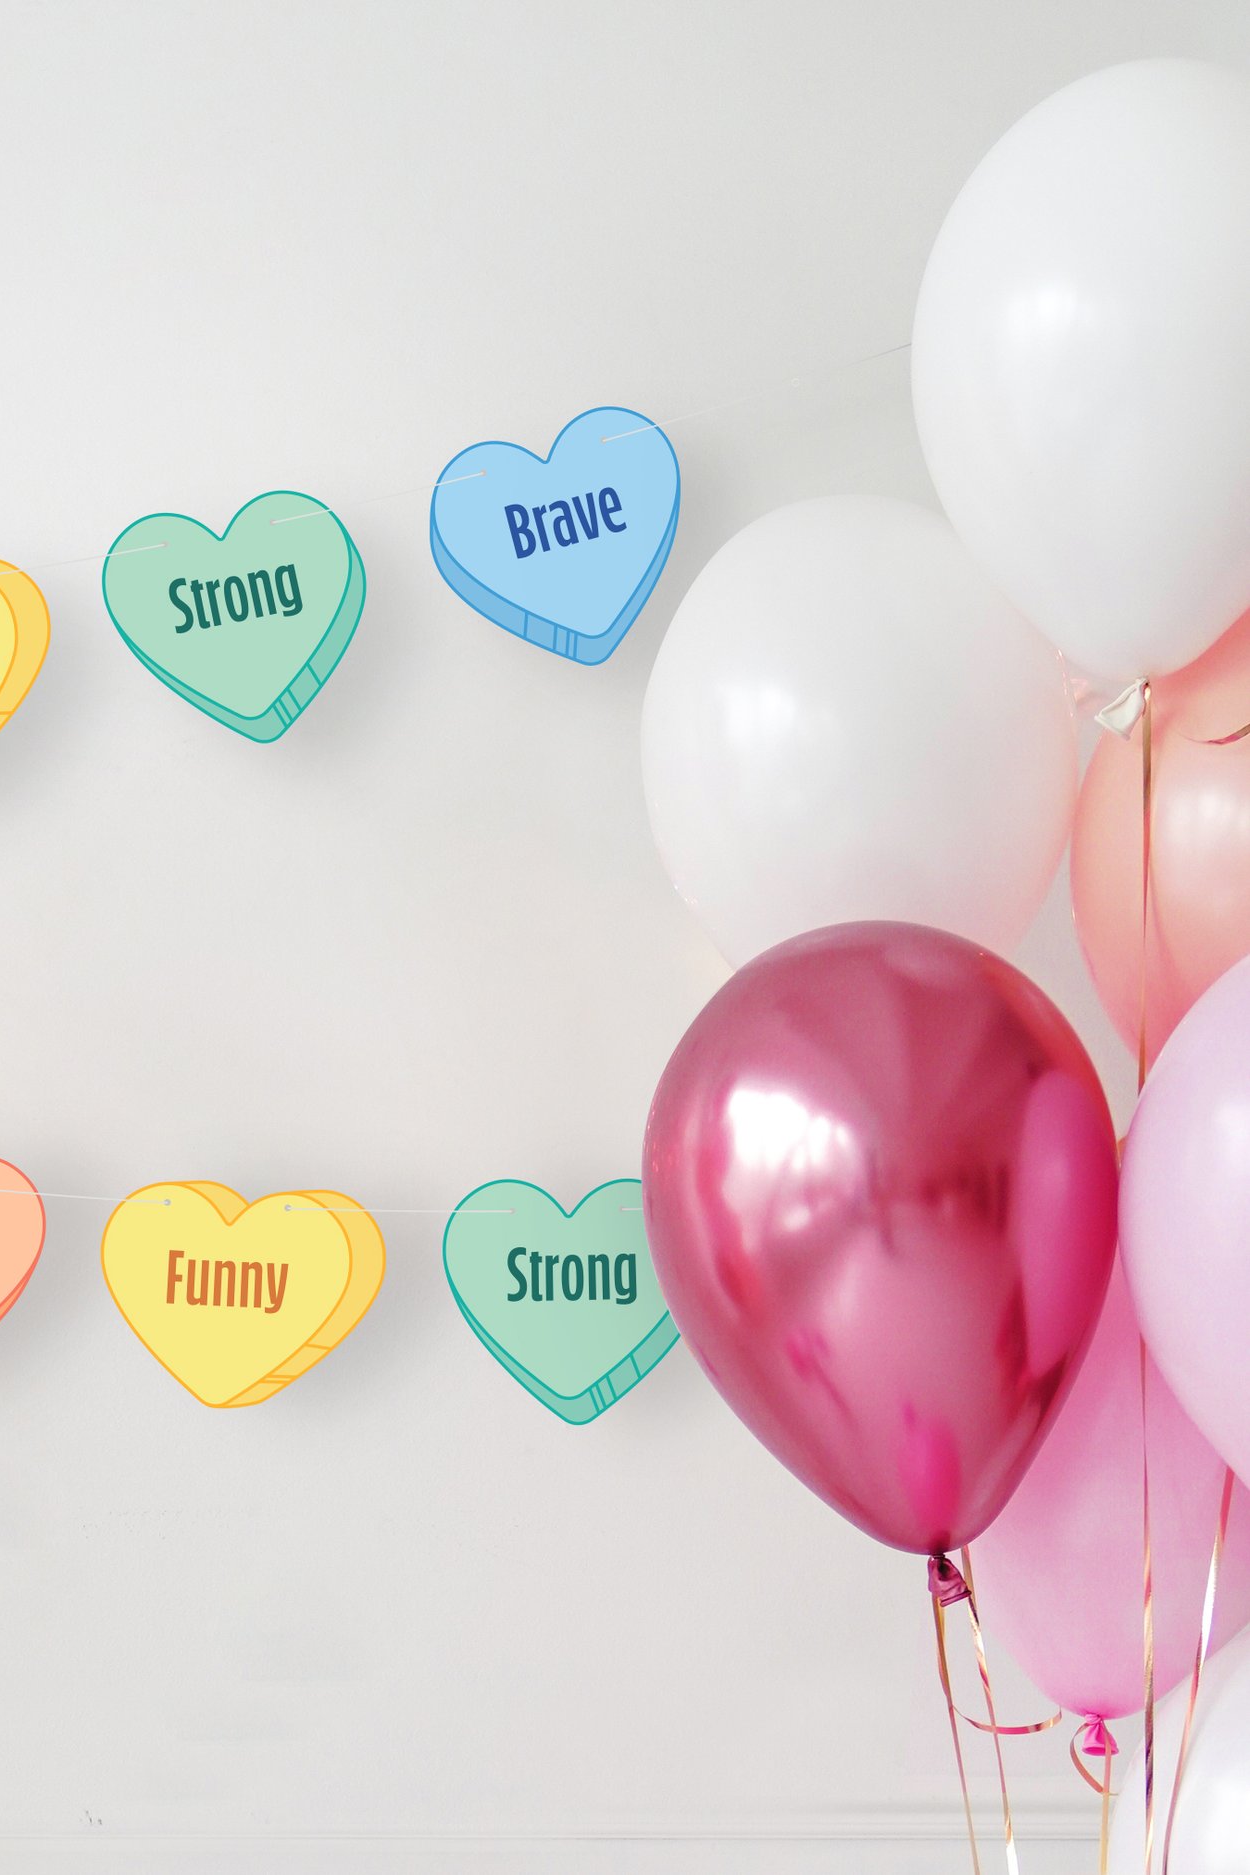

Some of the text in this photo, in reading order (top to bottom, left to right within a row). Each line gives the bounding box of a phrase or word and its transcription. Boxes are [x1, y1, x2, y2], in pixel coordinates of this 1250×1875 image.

[504, 486, 628, 560] Brave
[168, 563, 304, 634] Strong
[166, 1249, 289, 1314] Funny
[506, 1246, 638, 1306] Strong
